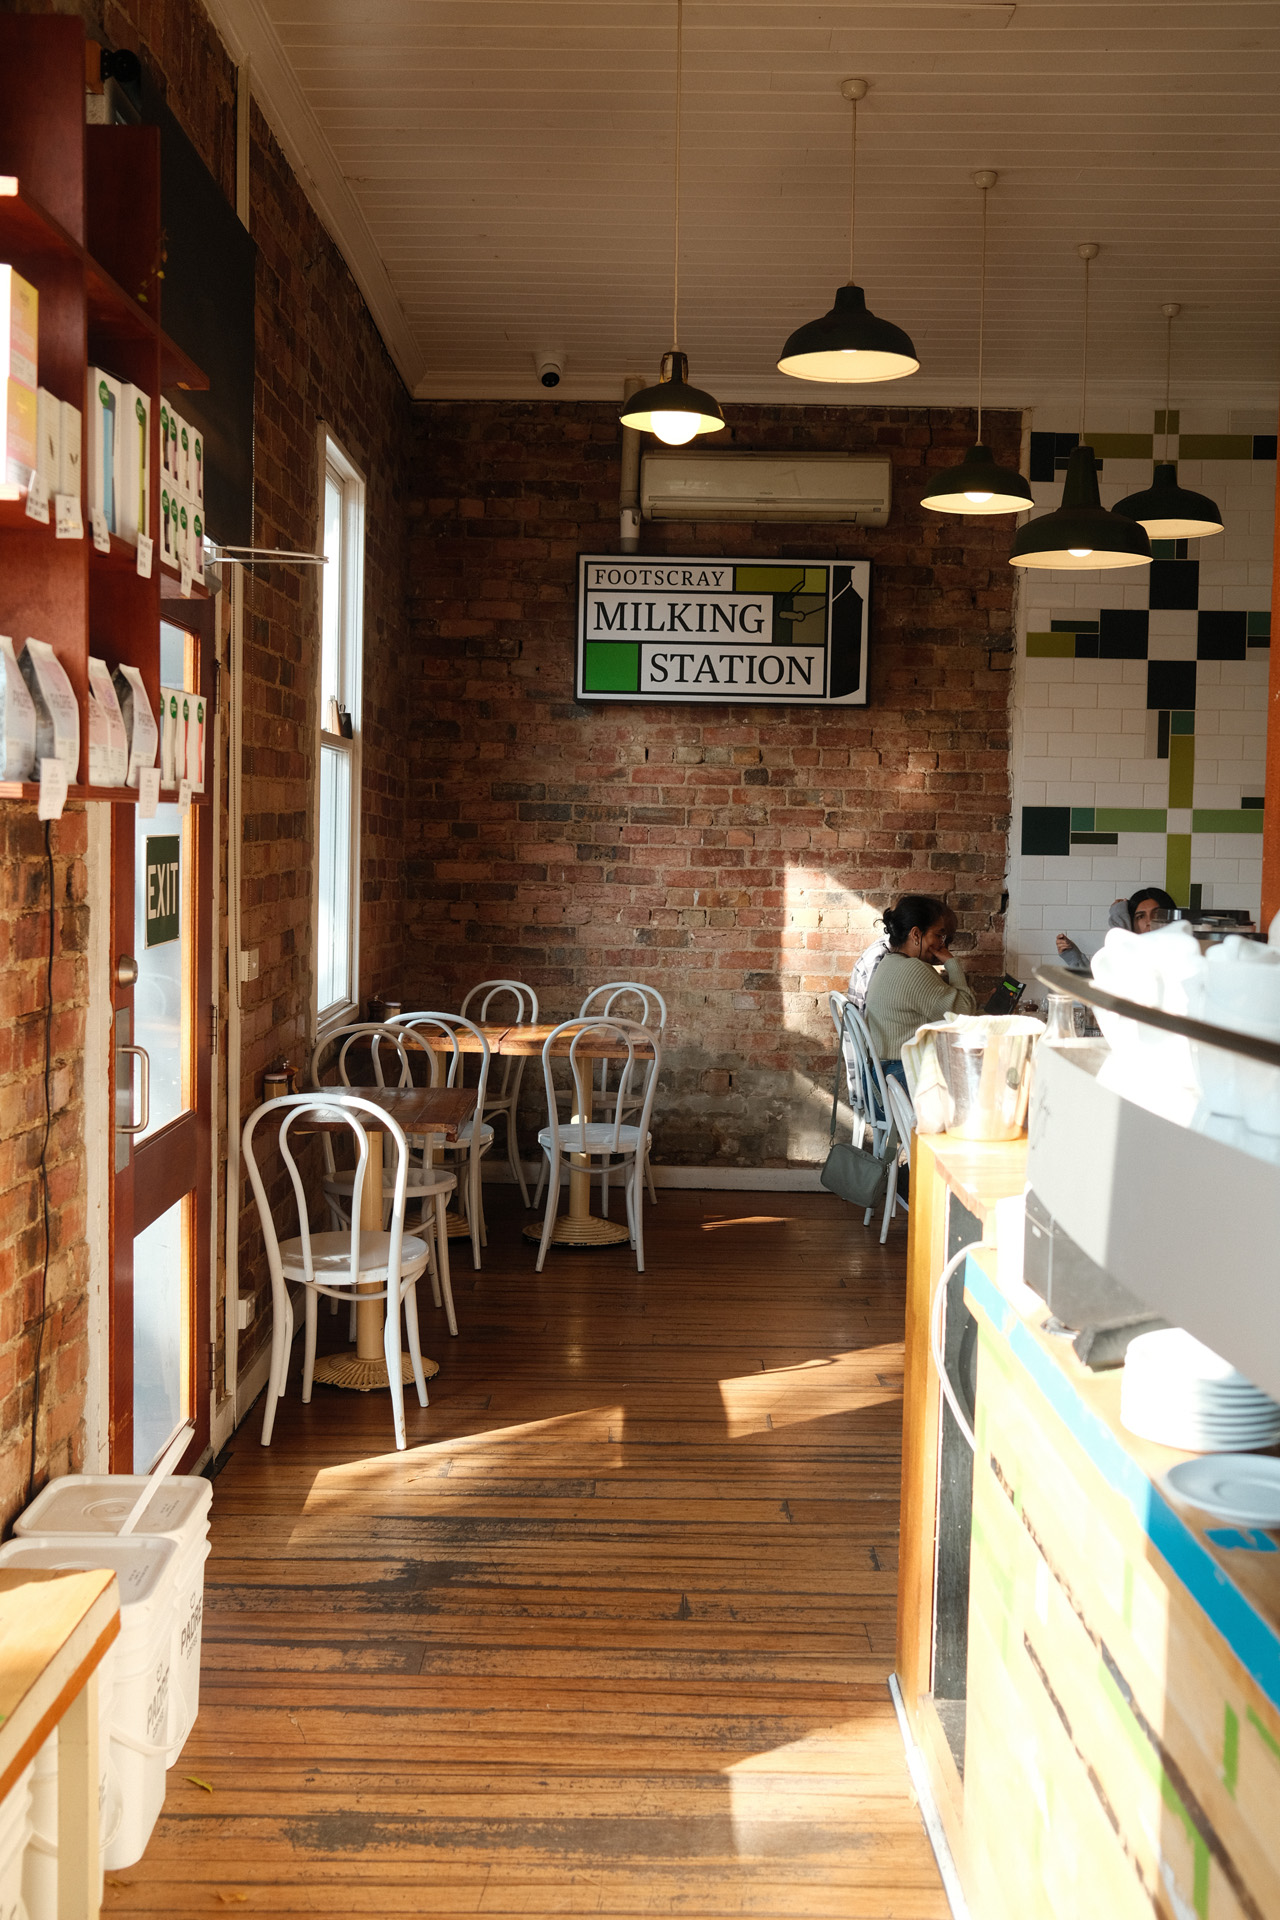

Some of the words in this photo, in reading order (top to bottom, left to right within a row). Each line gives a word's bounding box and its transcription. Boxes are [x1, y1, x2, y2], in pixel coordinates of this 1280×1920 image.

[594, 568, 725, 587] FOOTSCRAY
[593, 601, 765, 634] MILKING
[650, 653, 815, 685] STATION
[147, 862, 179, 920] EXIT
[181, 1596, 202, 1656] PADRE
